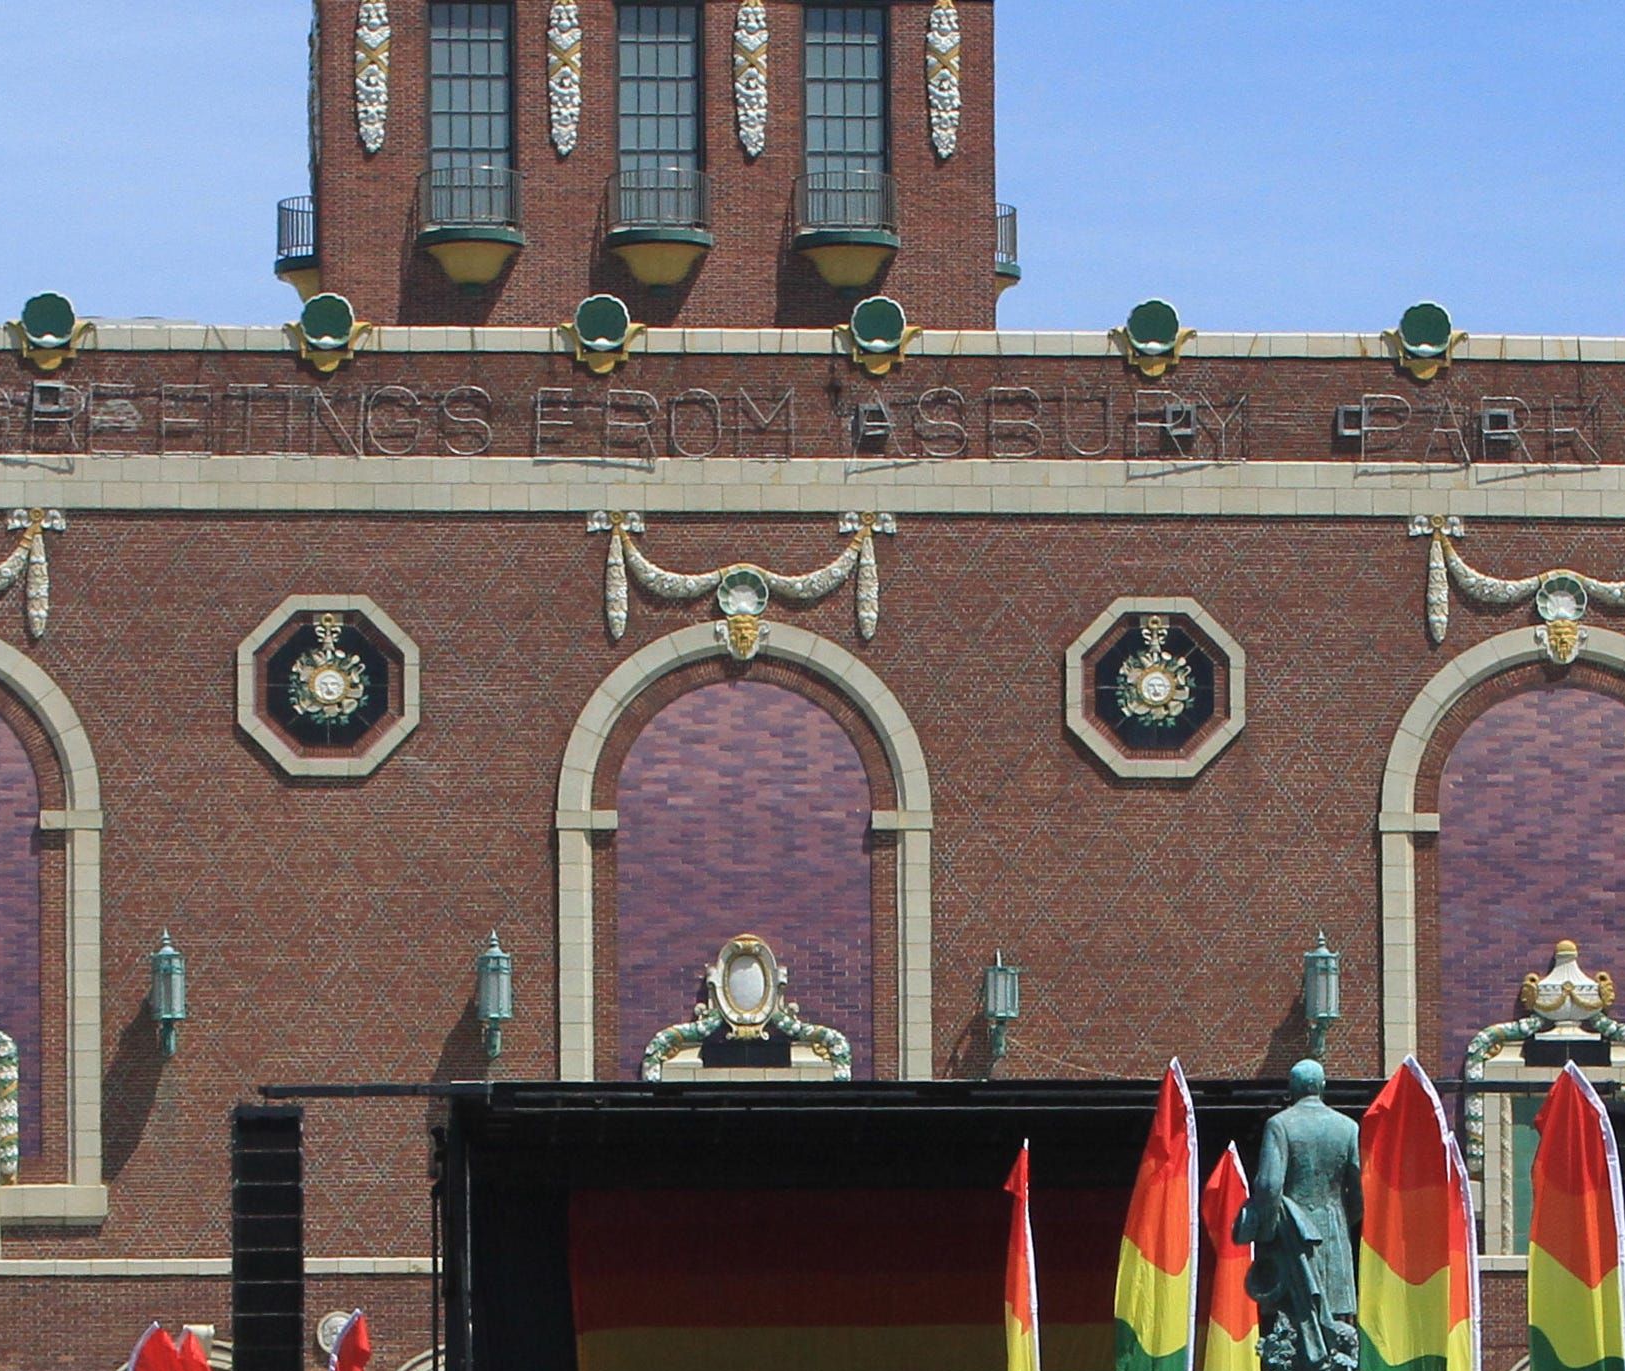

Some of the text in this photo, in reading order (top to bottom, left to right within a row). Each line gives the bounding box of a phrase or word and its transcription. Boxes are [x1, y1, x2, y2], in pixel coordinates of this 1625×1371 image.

[534, 386, 796, 461] FROM
[855, 386, 1247, 461] ASBURY
[1360, 393, 1601, 464] PARK
